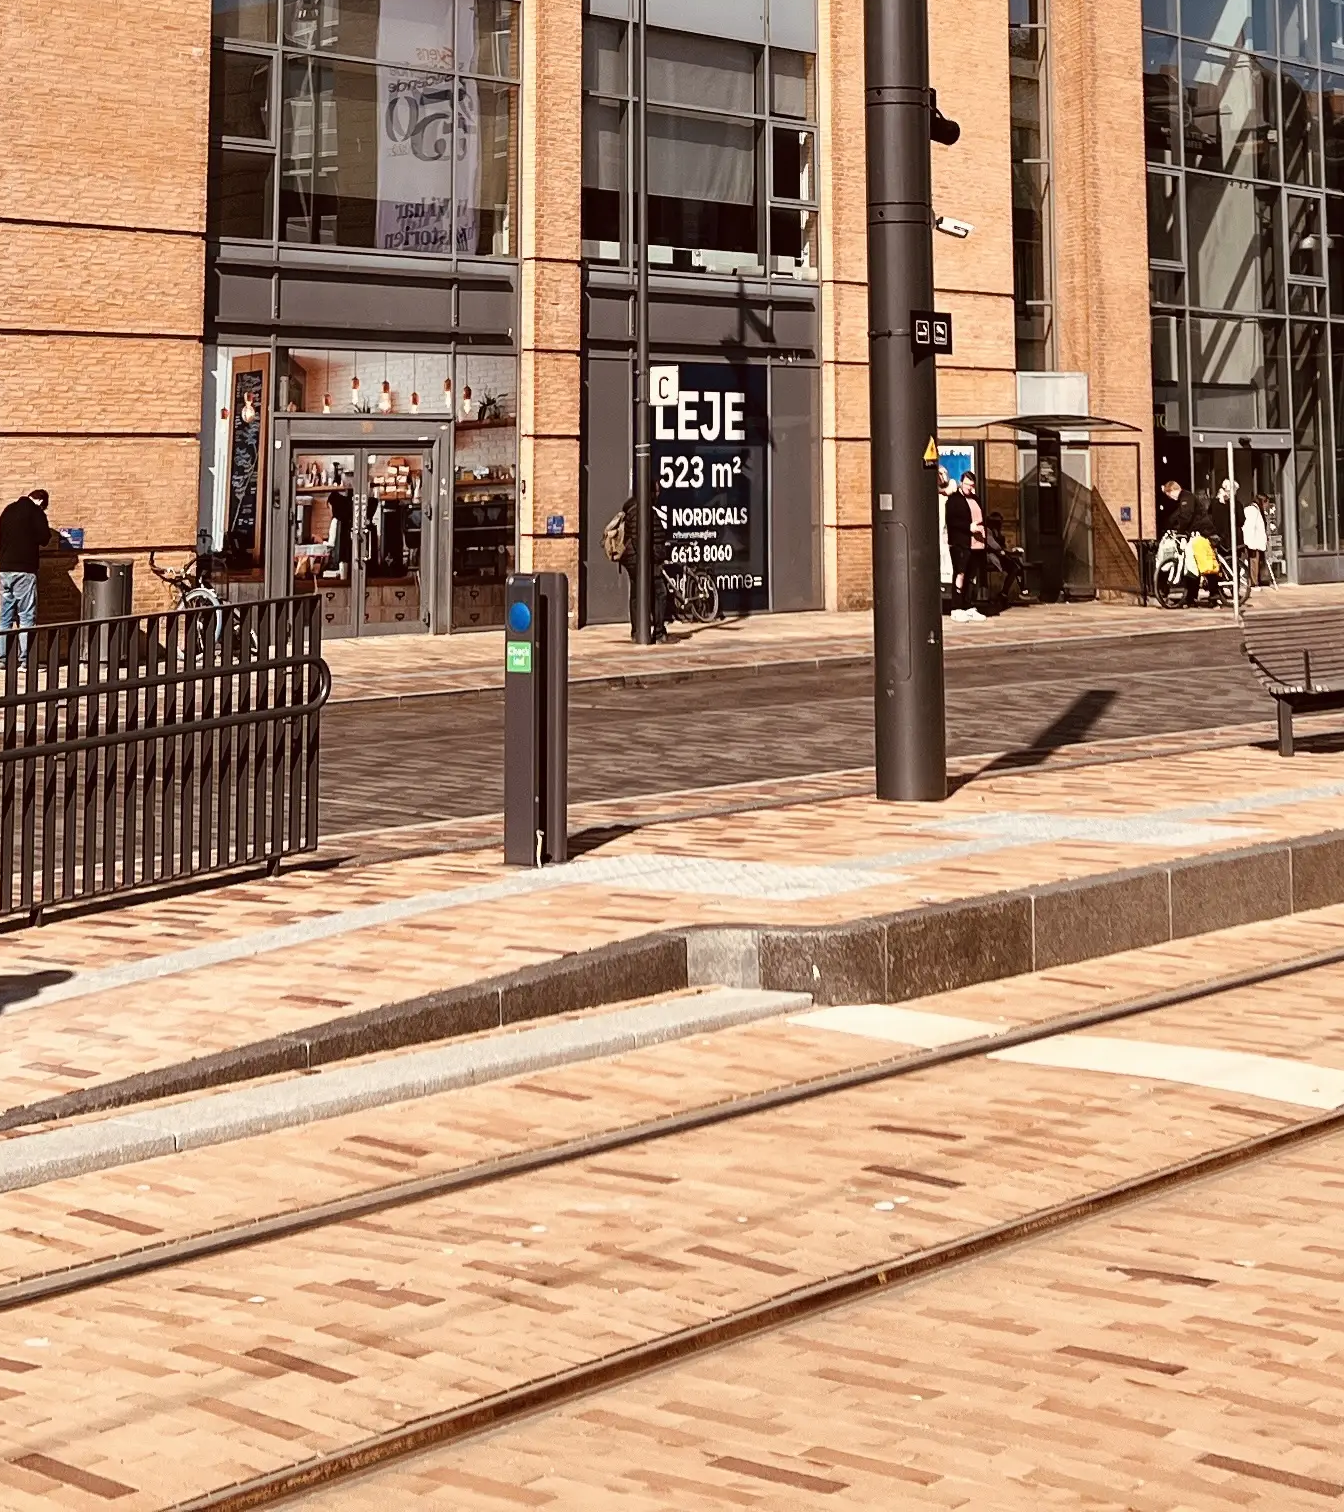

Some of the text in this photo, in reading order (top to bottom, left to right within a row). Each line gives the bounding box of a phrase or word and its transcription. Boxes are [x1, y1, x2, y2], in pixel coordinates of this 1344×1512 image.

[659, 376, 669, 399] C
[655, 390, 745, 441] LEJE
[659, 455, 704, 488] 523
[672, 506, 748, 527] NORDICALS
[671, 544, 733, 563] 6613 8060
